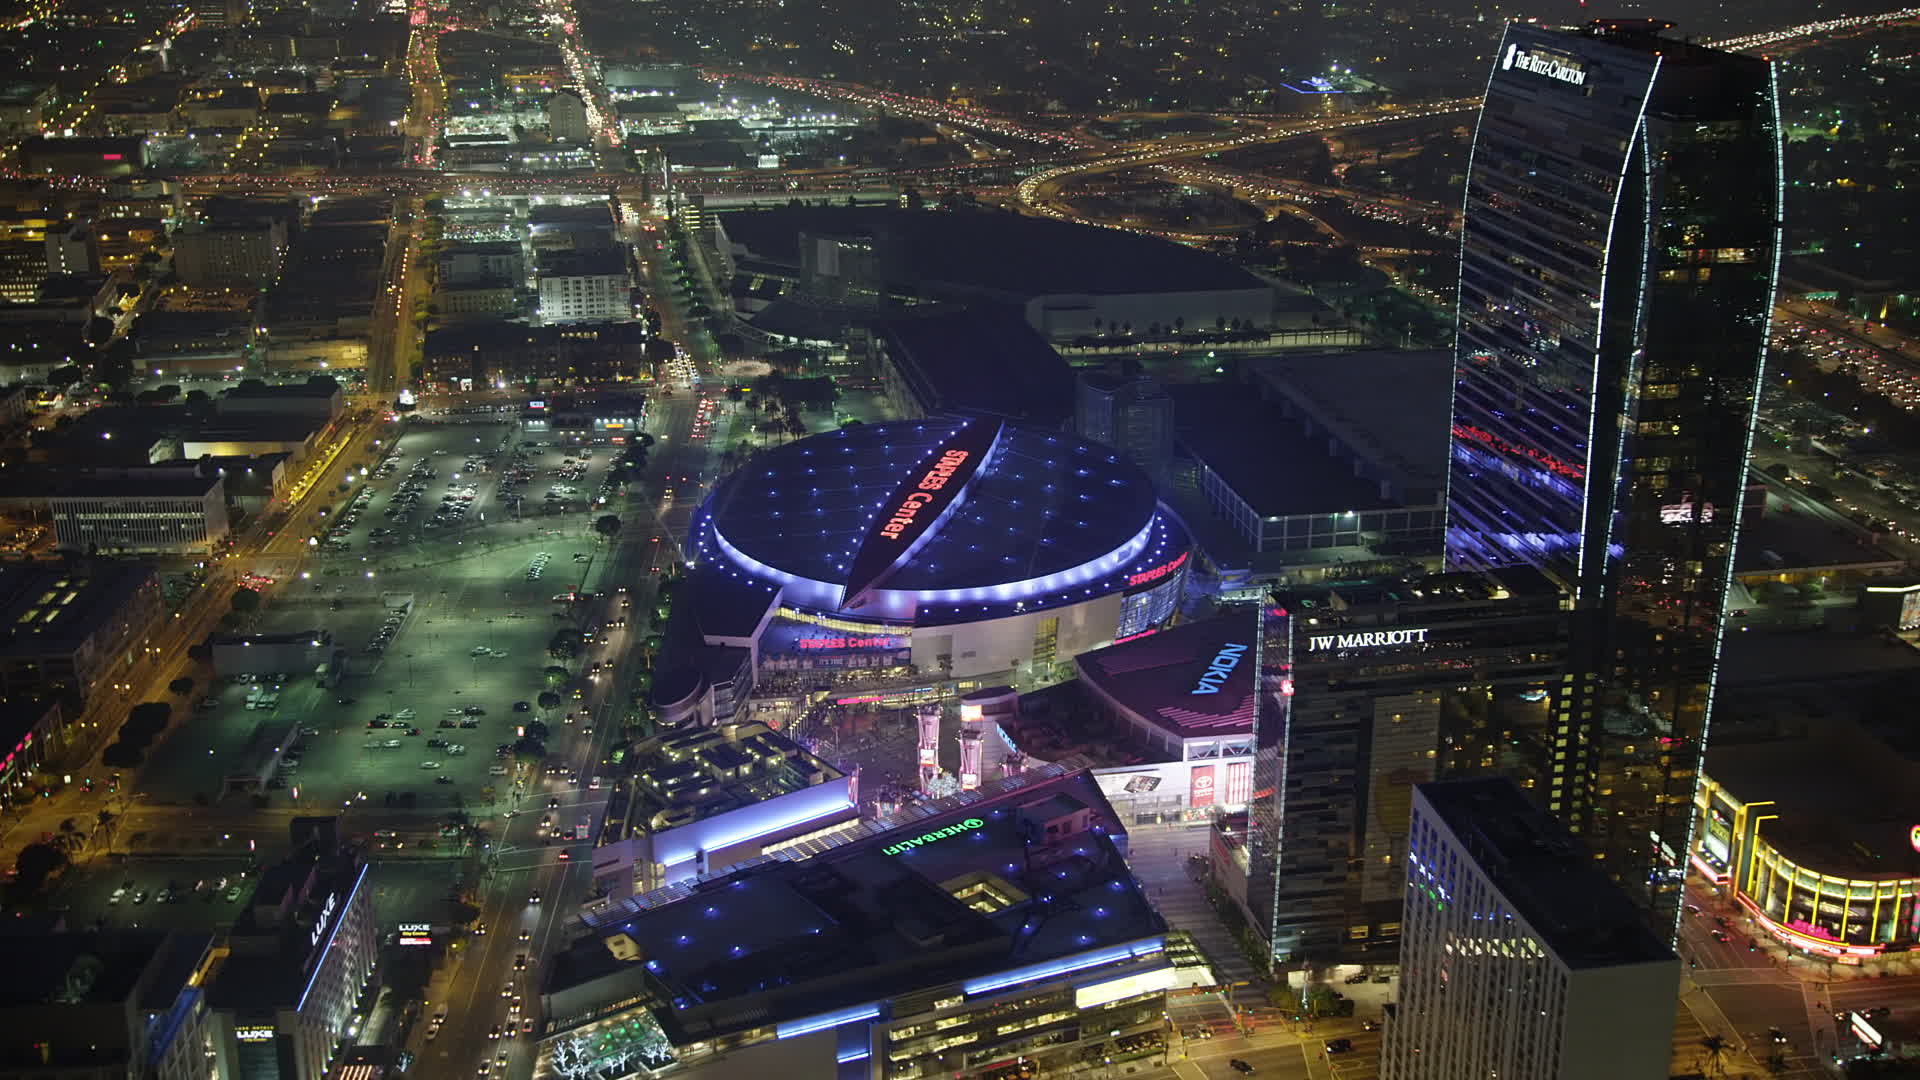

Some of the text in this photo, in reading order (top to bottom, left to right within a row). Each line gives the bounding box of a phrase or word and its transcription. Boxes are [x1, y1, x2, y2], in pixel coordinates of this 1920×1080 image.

[880, 449, 969, 540] STAPLES Center
[1129, 565, 1168, 586] STAPLES
[800, 638, 846, 649] STAPLES
[1309, 628, 1428, 652] JW MARRIOTT
[1191, 643, 1249, 695] NOKIA
[311, 892, 336, 946] LUXE
[236, 1030, 274, 1039] LUXE
